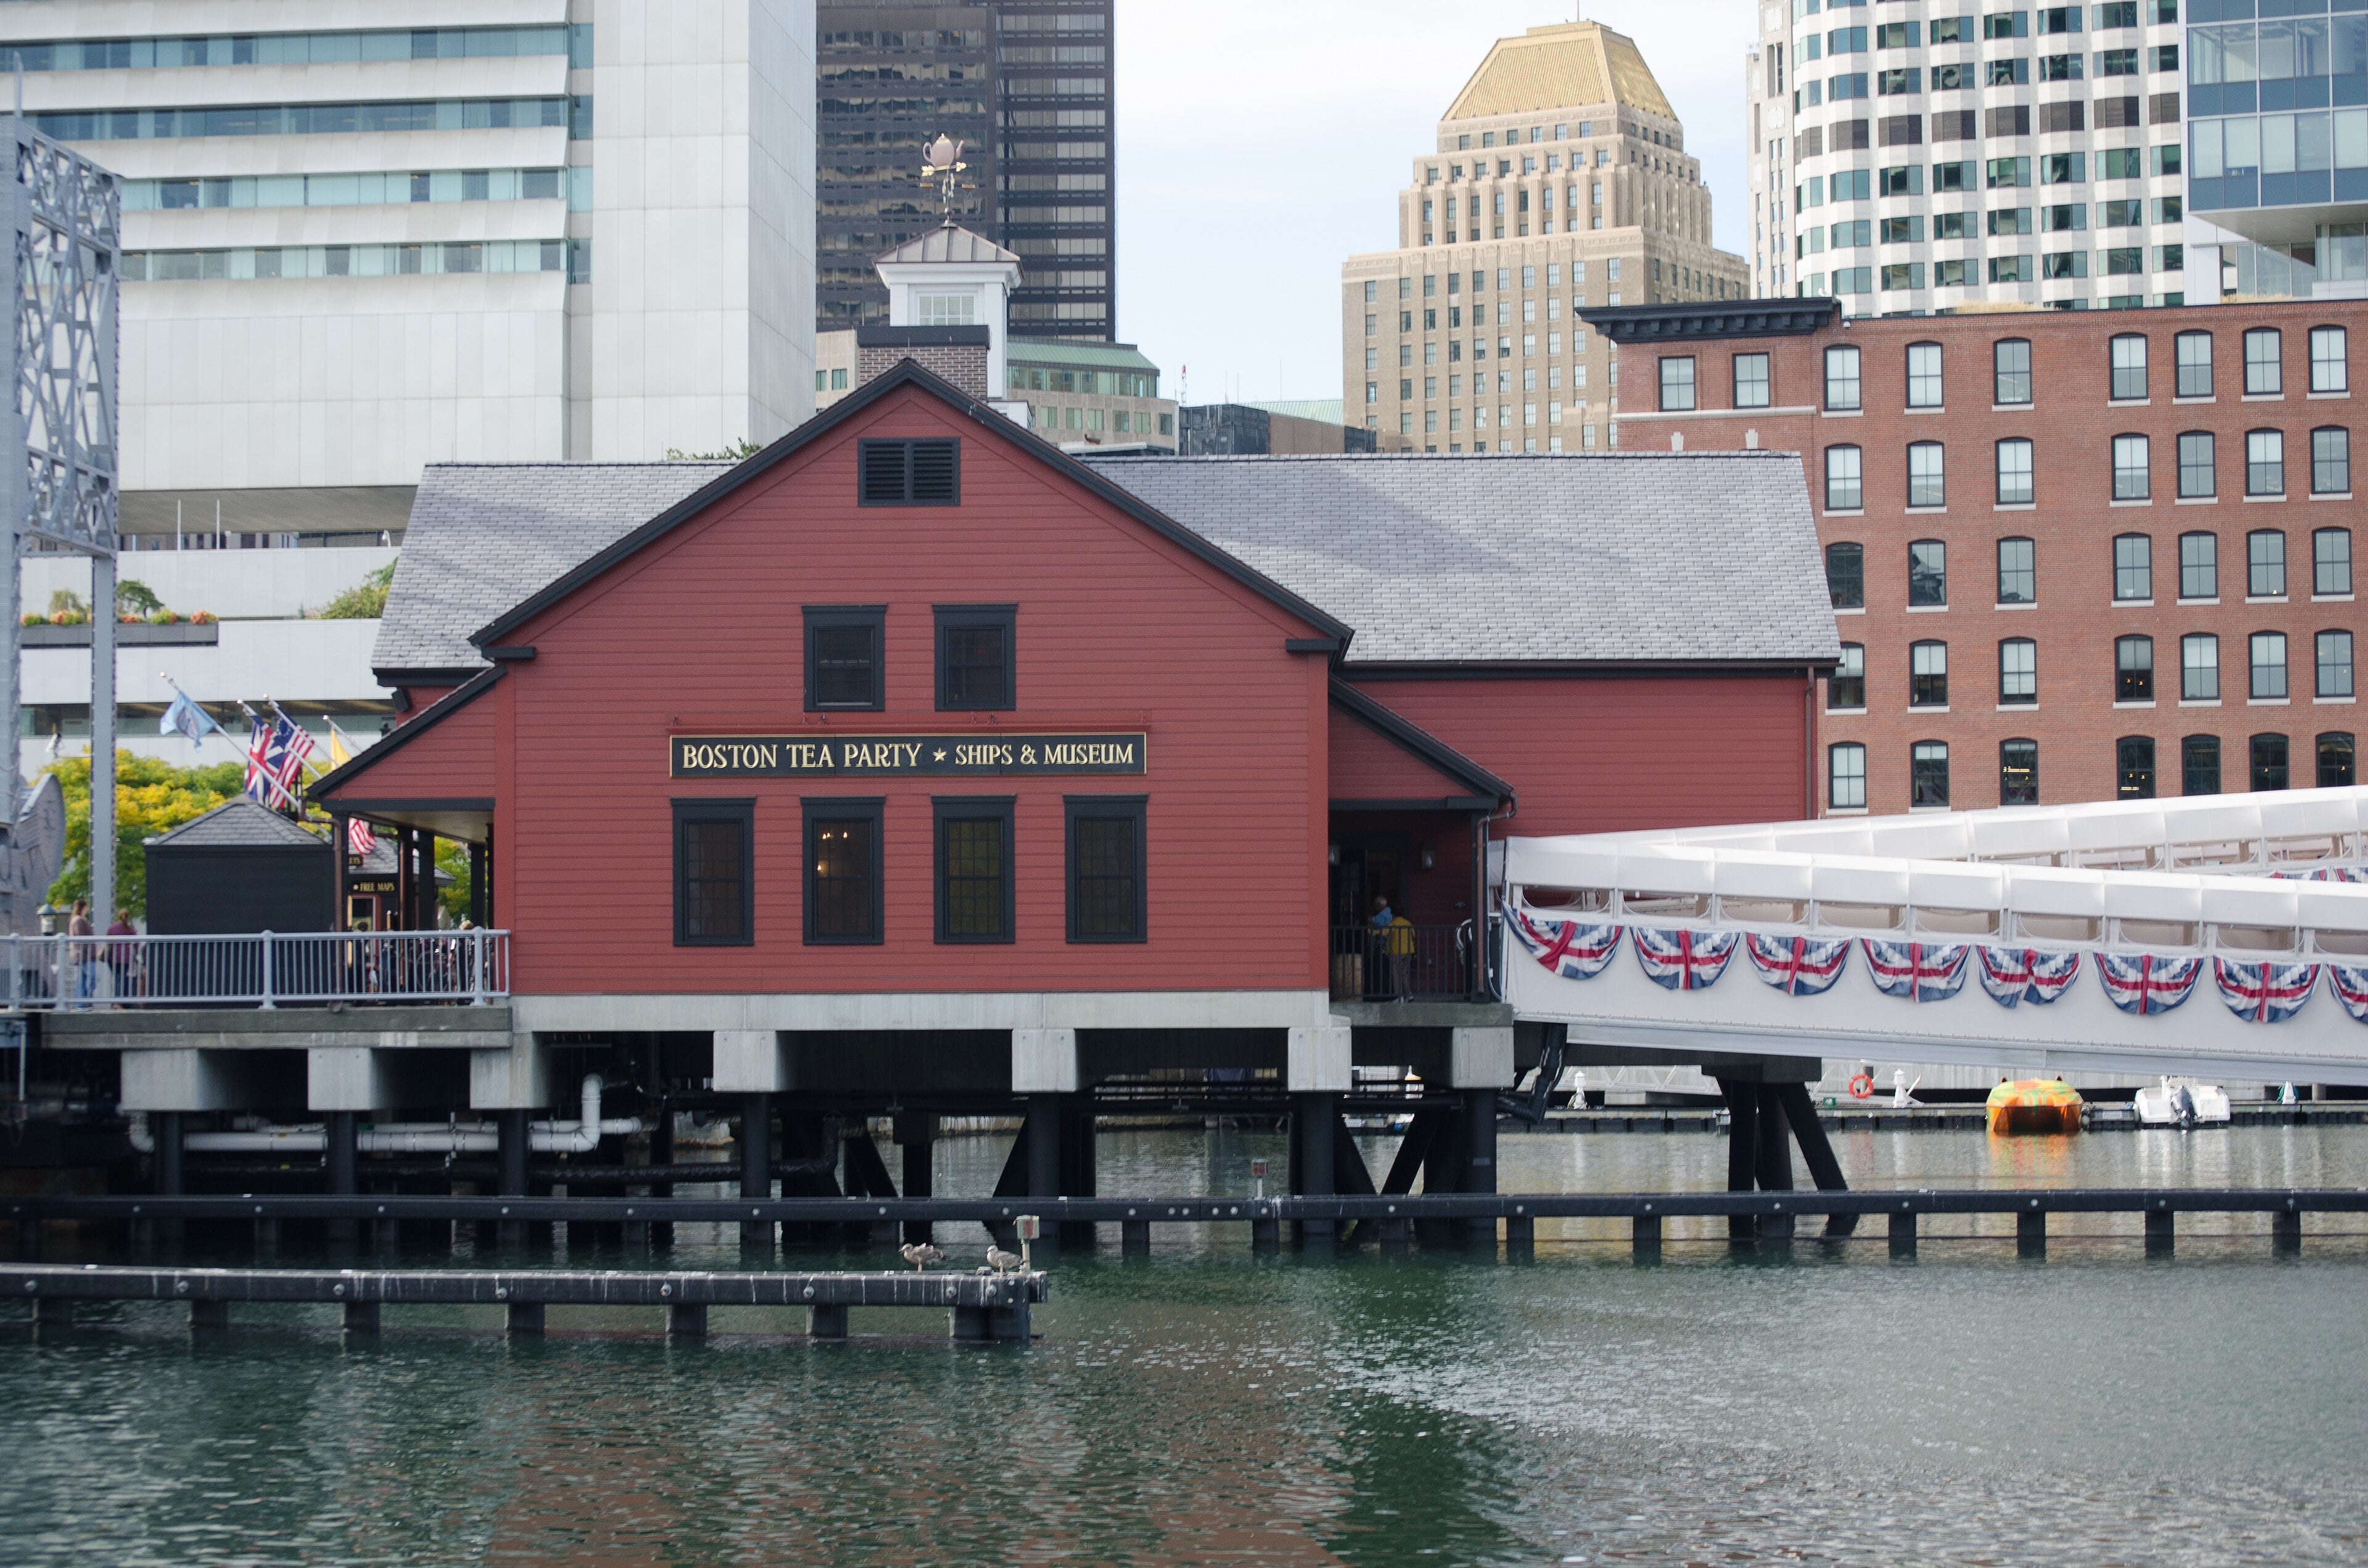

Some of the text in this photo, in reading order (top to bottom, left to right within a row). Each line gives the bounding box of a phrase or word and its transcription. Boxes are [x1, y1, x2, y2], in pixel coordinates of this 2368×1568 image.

[683, 743, 1133, 769] BOSTON TEA PARTY SHIPS & MUSEUM
[360, 882, 395, 892] FREE MAPS
